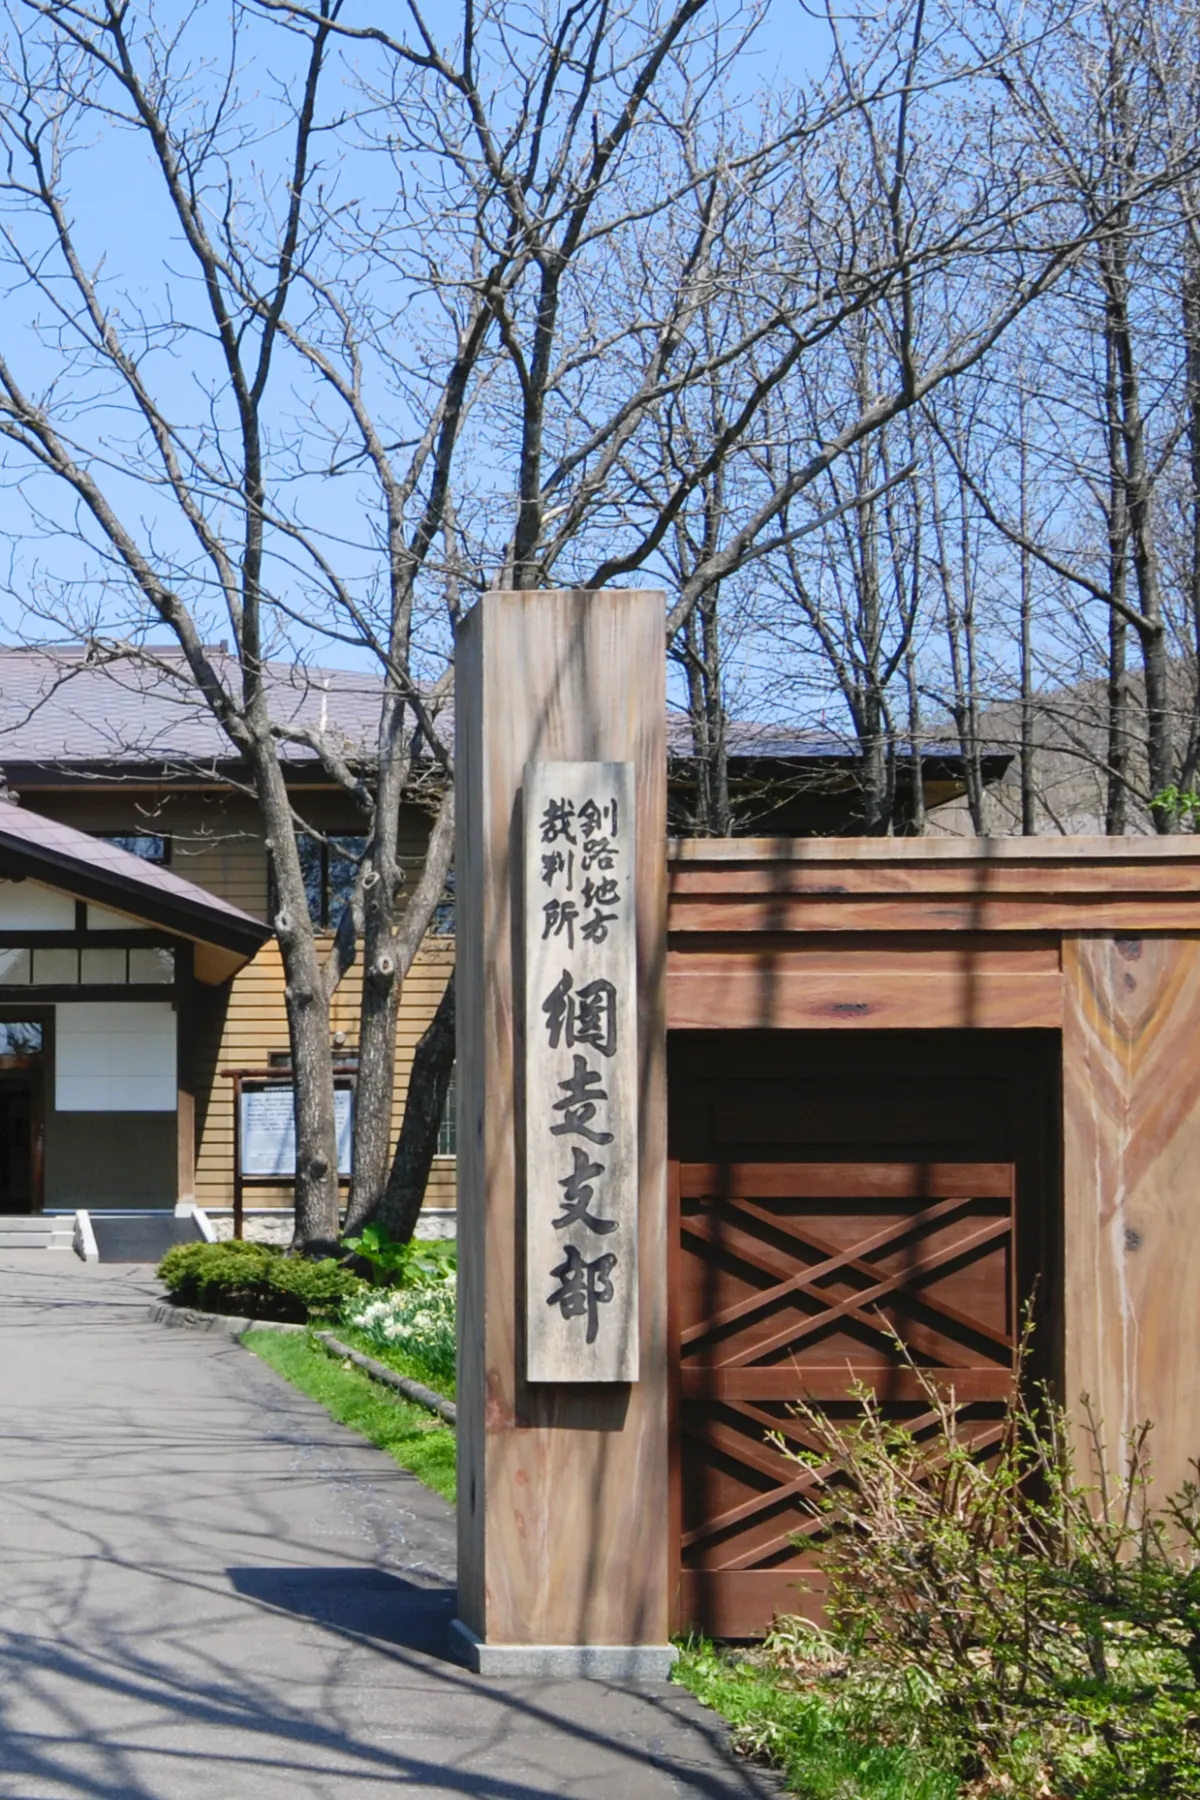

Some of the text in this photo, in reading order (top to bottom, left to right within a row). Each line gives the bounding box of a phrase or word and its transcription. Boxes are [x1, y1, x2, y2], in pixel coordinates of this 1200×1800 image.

[539, 797, 579, 950] 裁判所
[577, 797, 621, 945] 釧路地方
[541, 967, 620, 1345] 網走支部
